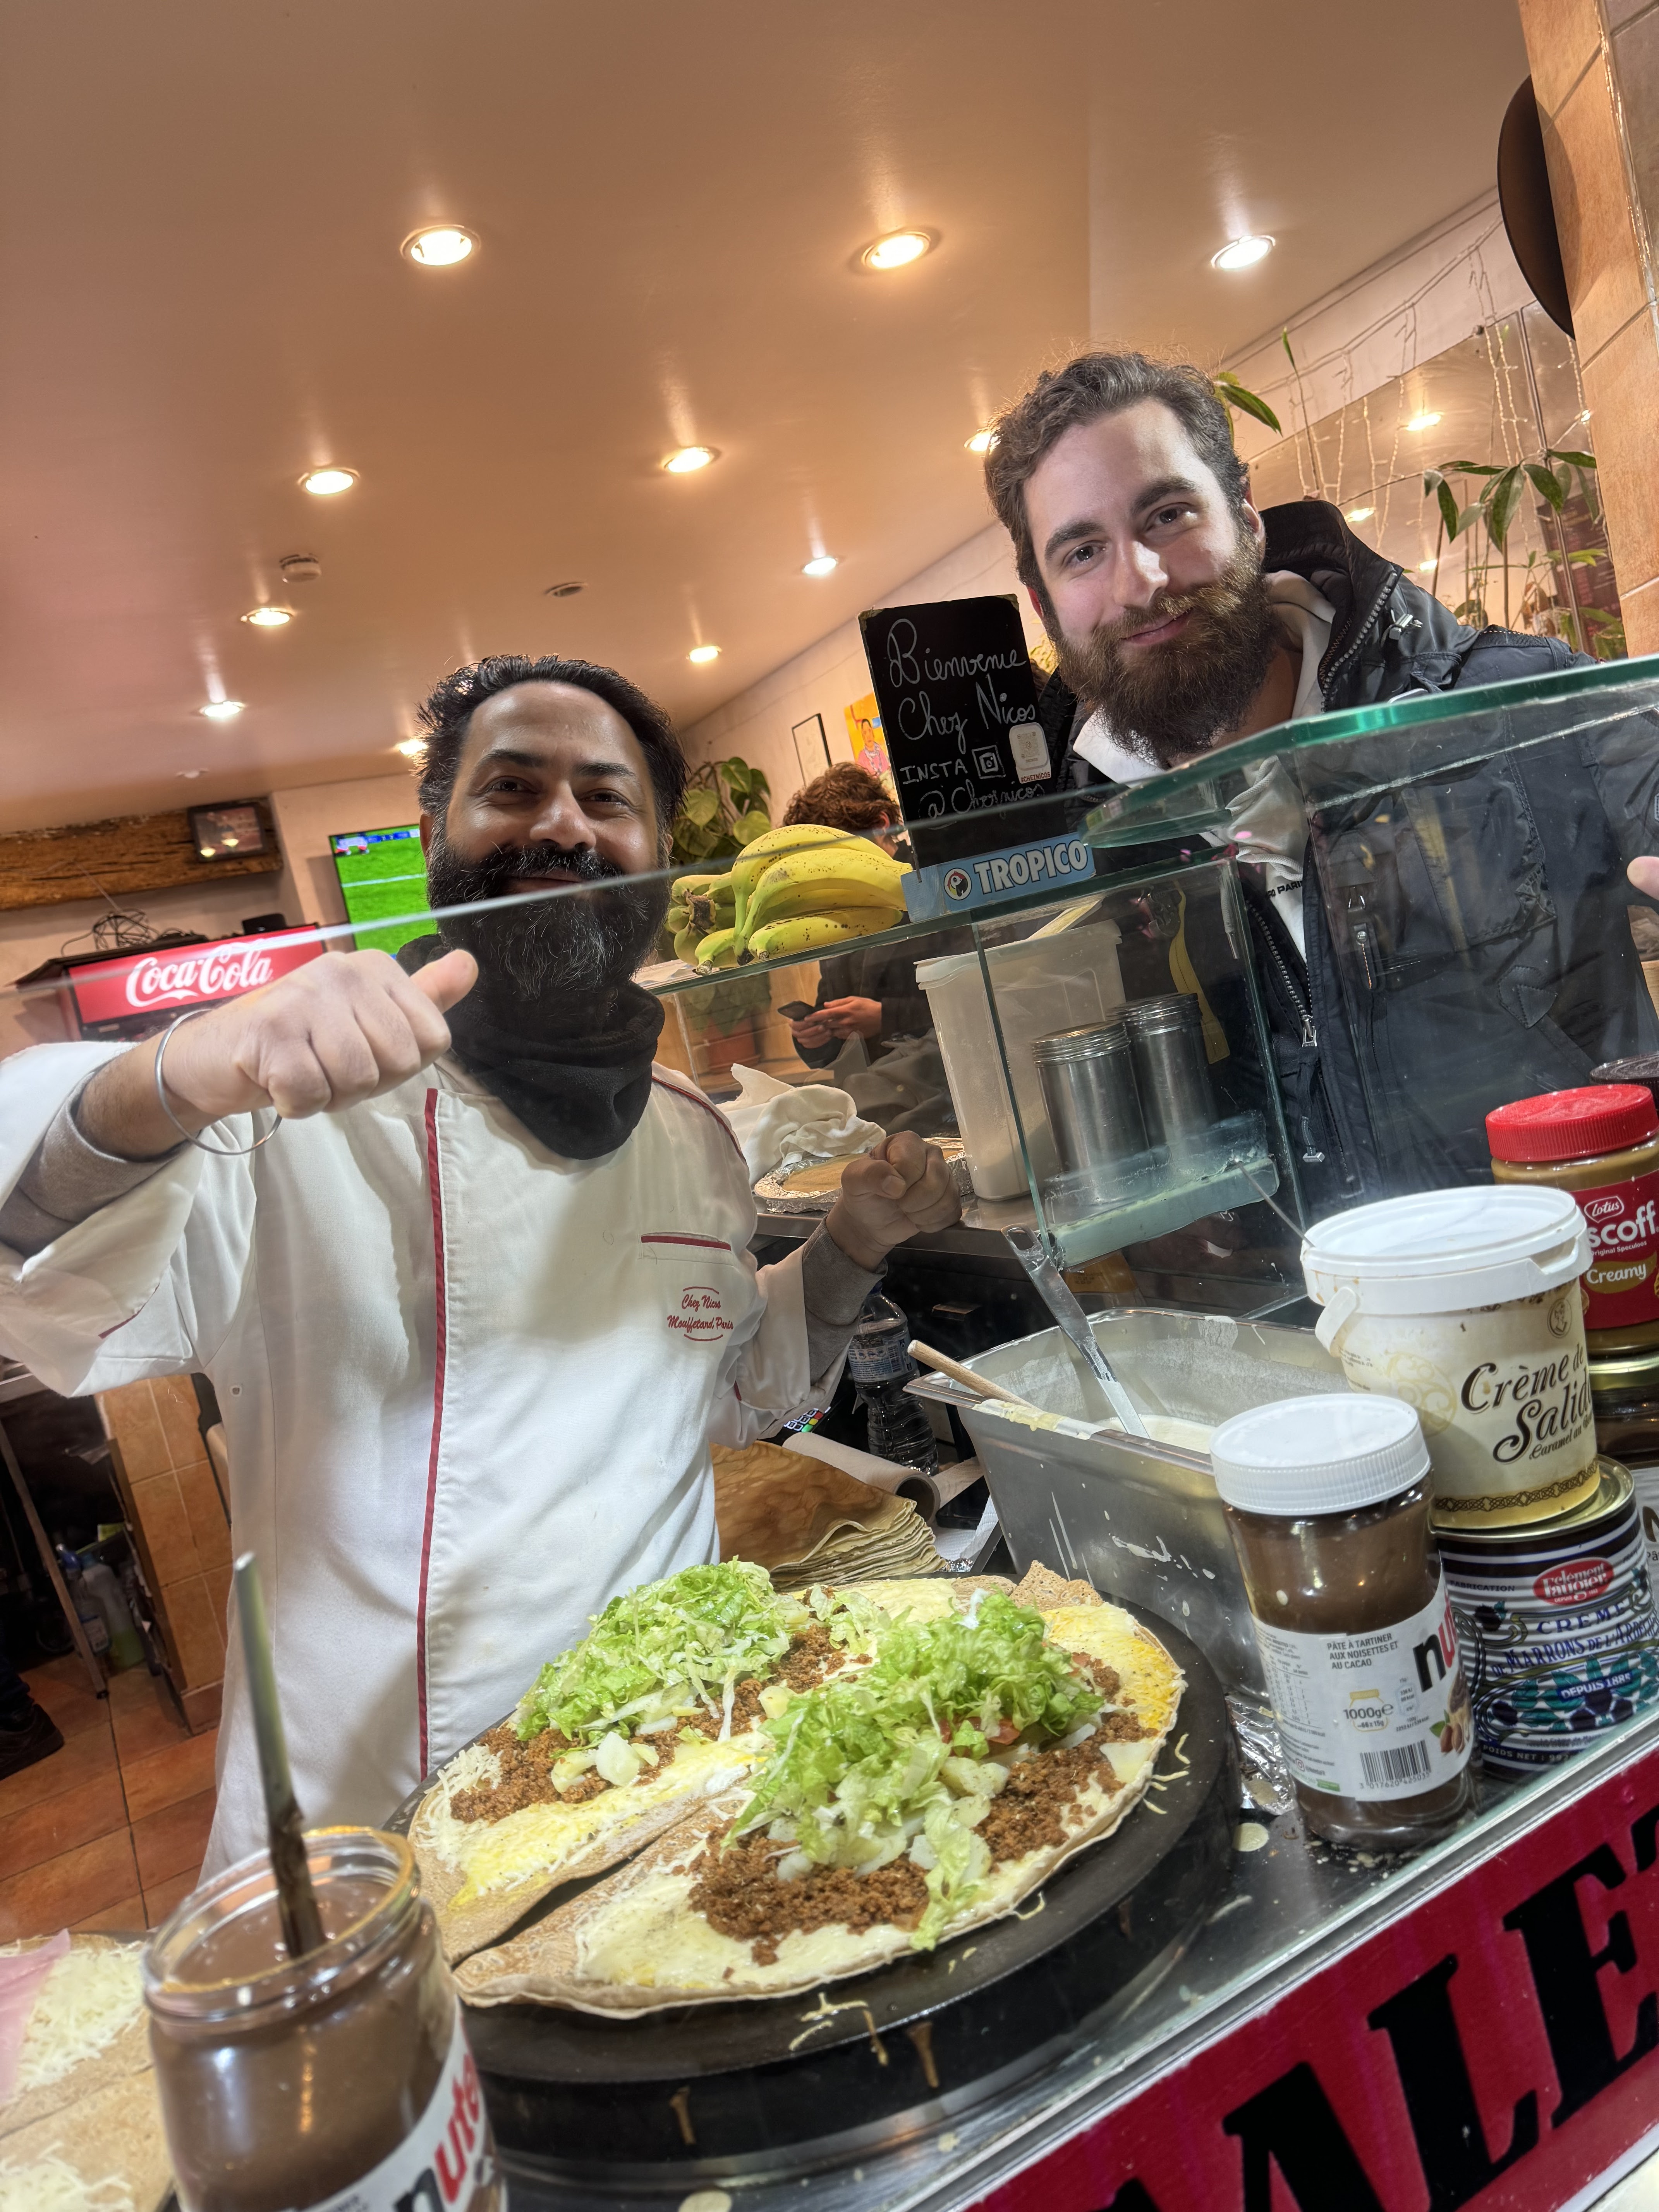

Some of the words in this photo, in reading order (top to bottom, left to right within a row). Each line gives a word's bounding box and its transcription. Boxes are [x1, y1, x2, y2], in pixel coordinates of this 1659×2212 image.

[898, 691, 968, 754] Chez
[975, 673, 1036, 730] Nicos
[900, 759, 968, 784] INSTA
[1020, 771, 1051, 782] #CHEZNICOS
[974, 839, 1088, 894] TROPICO
[1277, 880, 1302, 894] PARI
[125, 939, 273, 1007] Coca-Cola
[1592, 1201, 1620, 1217] Lotus
[1587, 1200, 1656, 1248] scoff
[1616, 1241, 1647, 1253] Speculoos
[1586, 1263, 1647, 1284] Creamy
[682, 1294, 700, 1312] Chez
[667, 1315, 715, 1333] Mouffetard
[715, 1316, 734, 1329] Paris
[1461, 1354, 1569, 1412] Crème
[1573, 1342, 1583, 1371] de
[1528, 1429, 1573, 1460] Caramel
[1450, 1580, 1515, 1592] FABRICATION
[1327, 1641, 1346, 1650] PÂTE
[1348, 1639, 1354, 1649] À
[1356, 1633, 1392, 1647] TARTINER
[1330, 1652, 1346, 1660] AUX
[1347, 1644, 1389, 1659] NOISETTES
[1390, 1641, 1398, 1650] ET
[1332, 1661, 1343, 1669] AU
[1344, 1658, 1372, 1669] CACAO
[1503, 1637, 1585, 1673] MARRONS
[1588, 1637, 1602, 1651] DE
[1560, 1680, 1605, 1699] DEPUIS
[1483, 1744, 1513, 1757] POIDS
[1087, 1803, 1659, 2212] ALE
